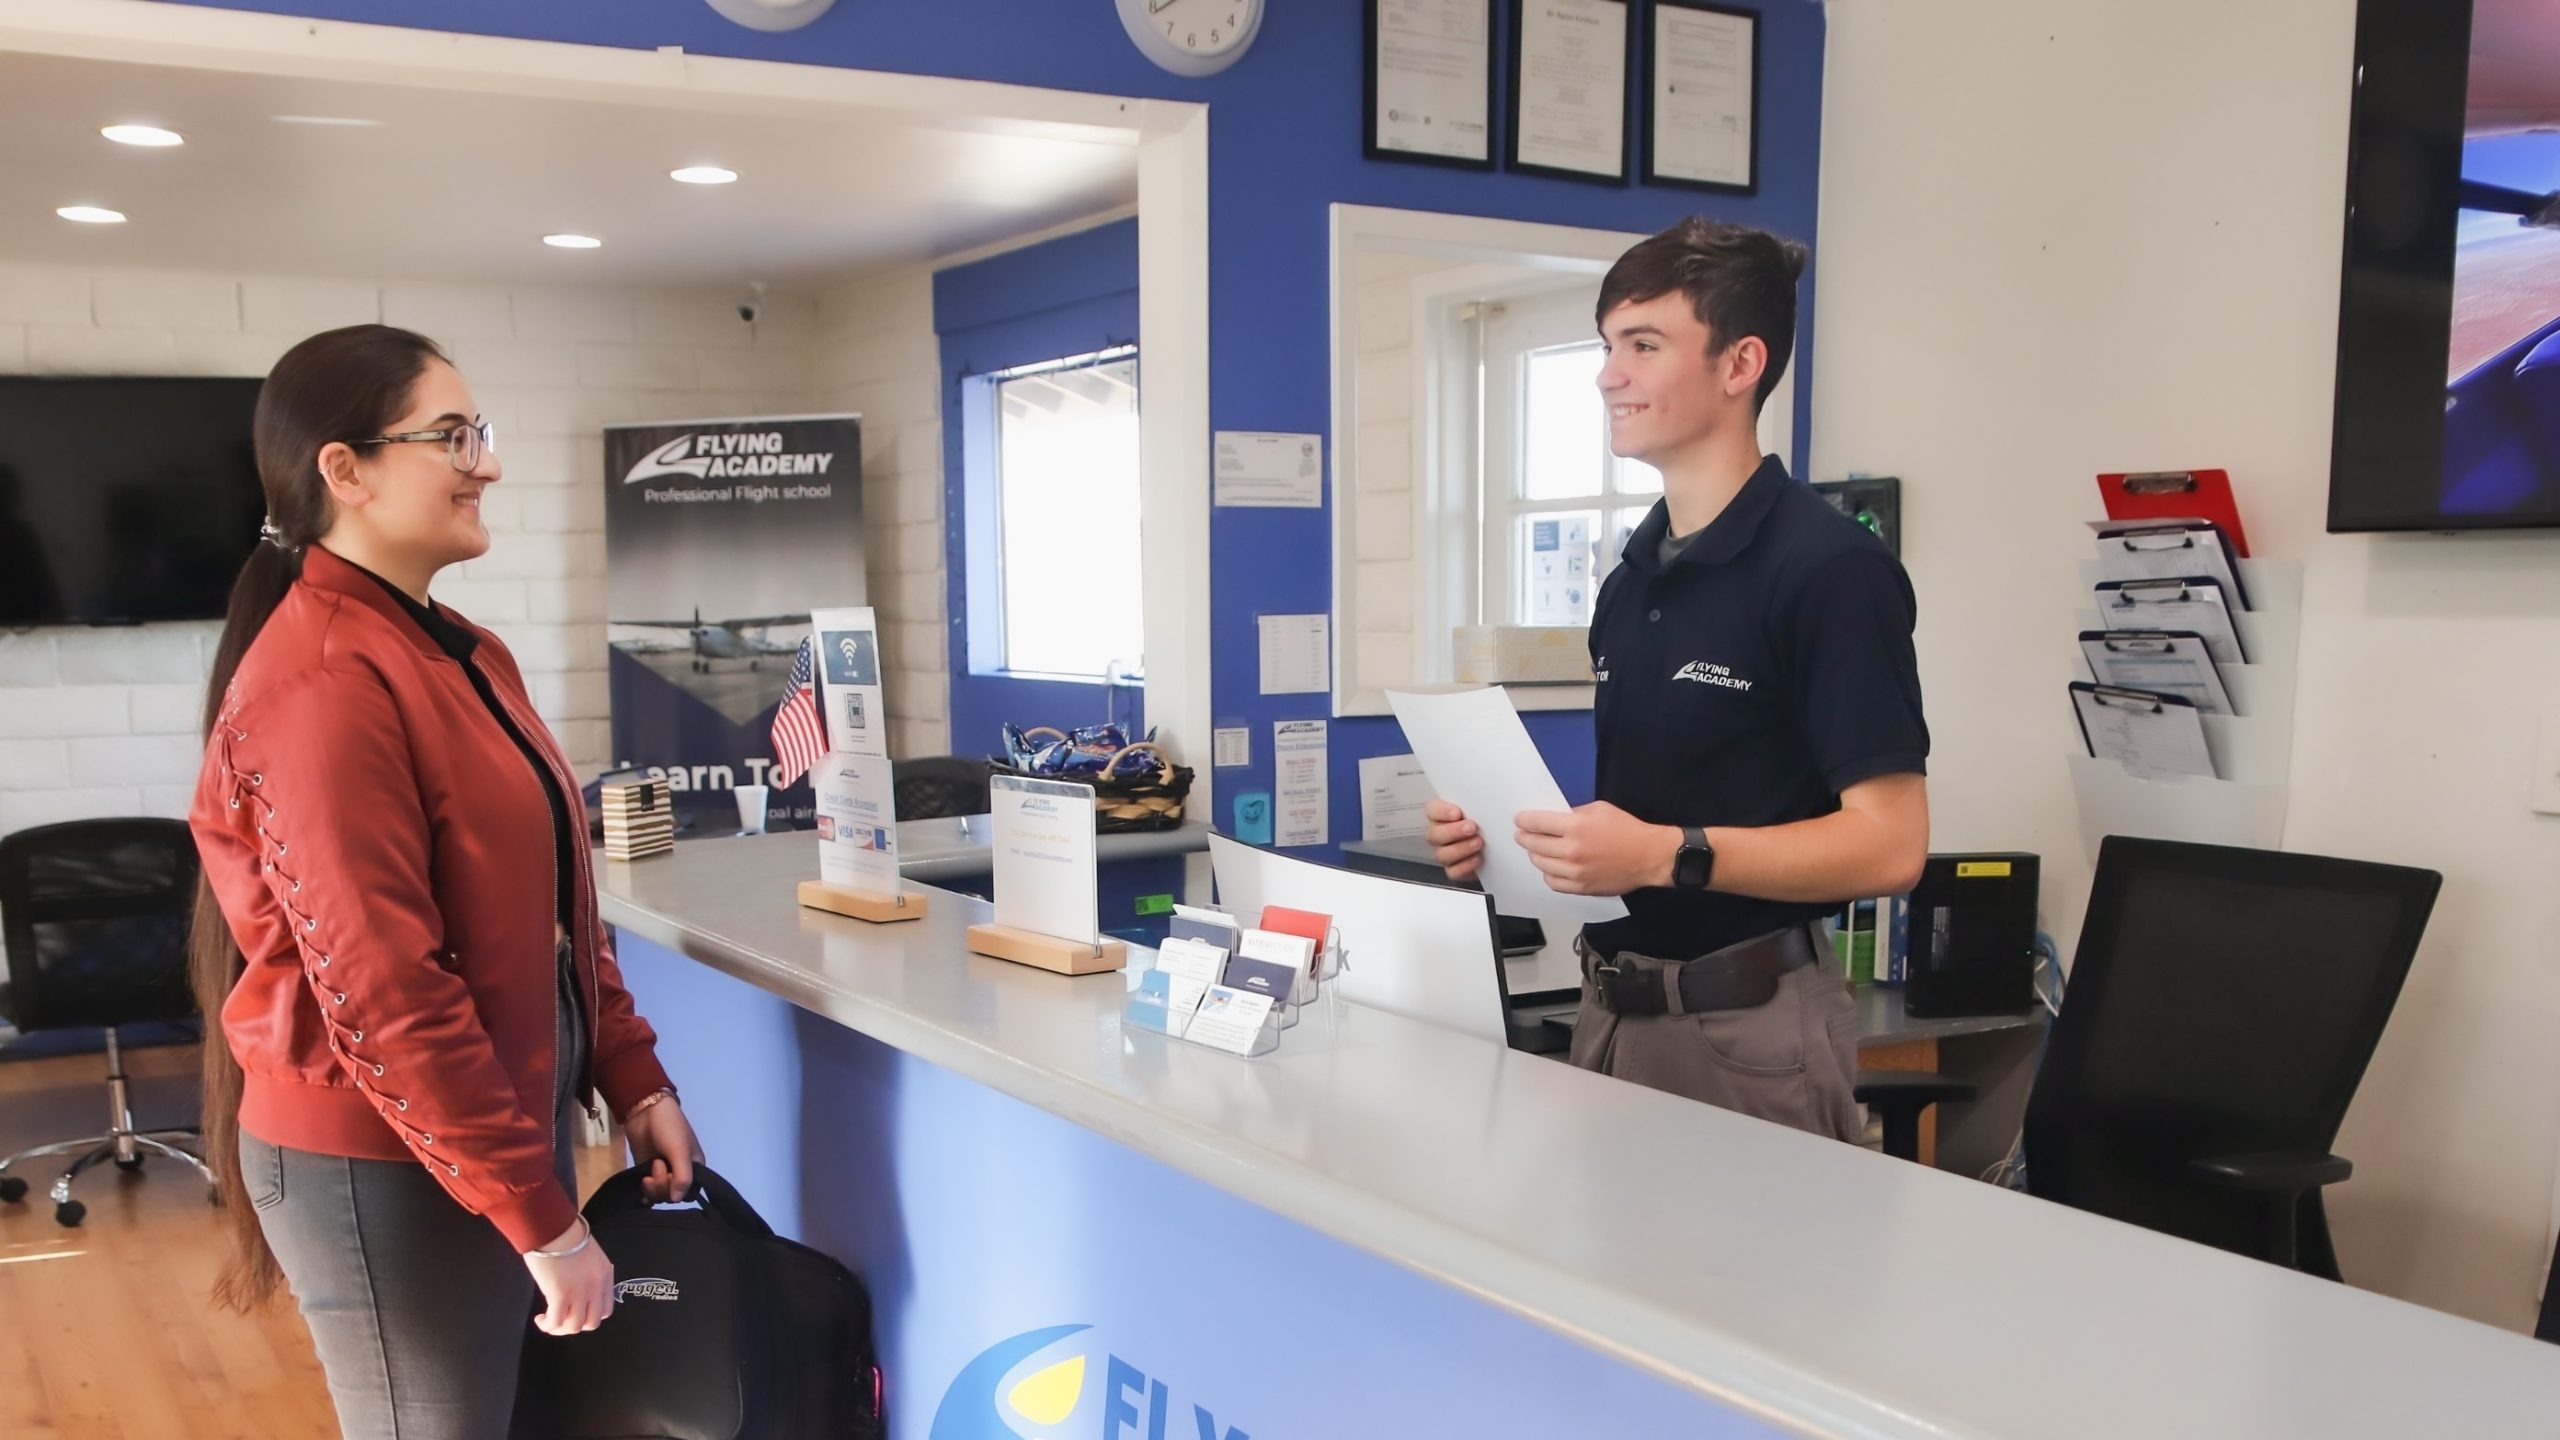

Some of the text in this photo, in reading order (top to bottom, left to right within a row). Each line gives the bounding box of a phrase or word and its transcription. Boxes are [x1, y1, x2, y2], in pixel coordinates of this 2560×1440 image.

[696, 432, 783, 456] FLYING
[708, 453, 834, 478] ACADEMY
[644, 484, 832, 504] Professional Flight school
[1697, 662, 1730, 676] FLYING
[1696, 674, 1753, 691] ACADEMY
